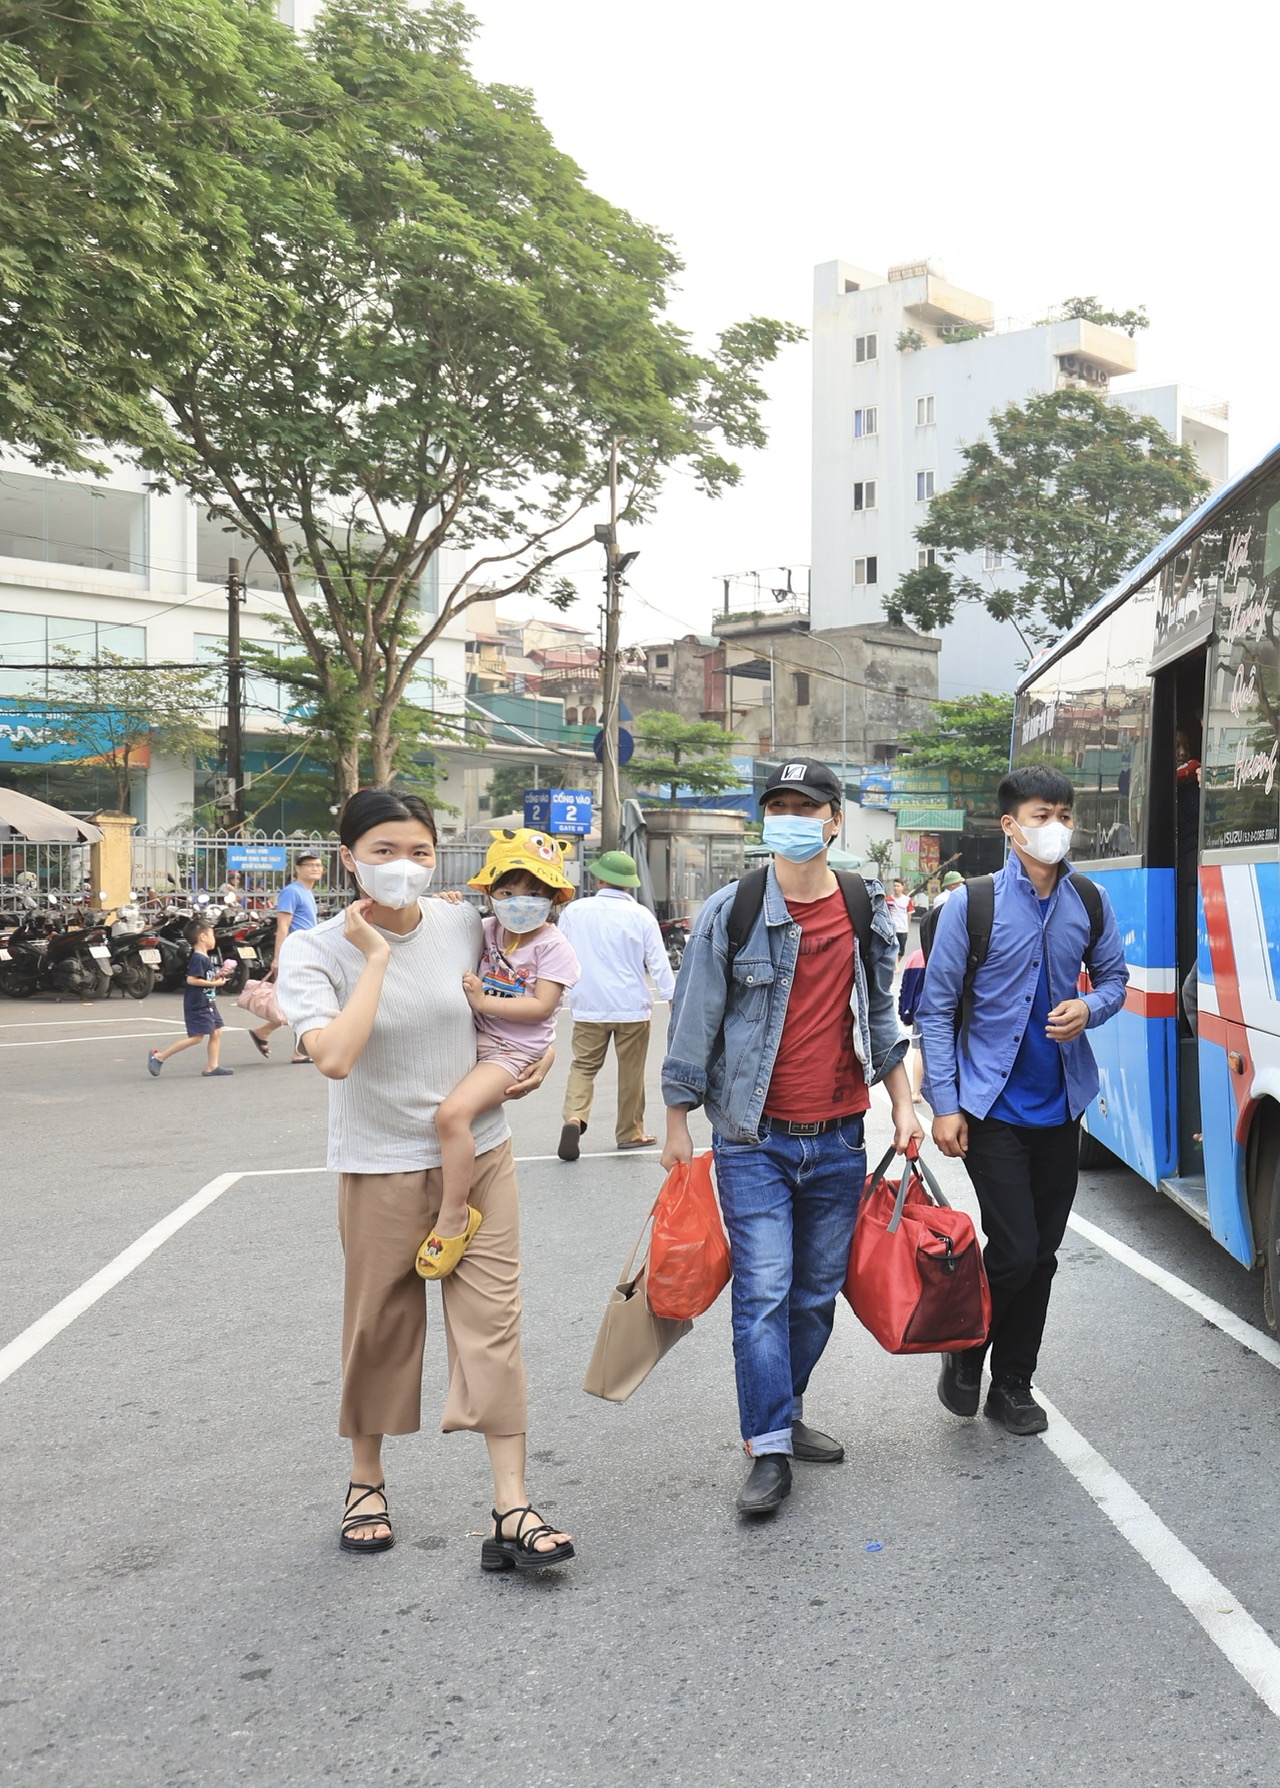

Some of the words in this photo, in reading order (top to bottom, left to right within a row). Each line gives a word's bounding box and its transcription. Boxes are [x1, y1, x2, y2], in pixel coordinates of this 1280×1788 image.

[575, 793, 591, 805] VÀO
[532, 805, 540, 820] 2
[566, 805, 577, 821] 2
[1224, 830, 1243, 845] ISUZU
